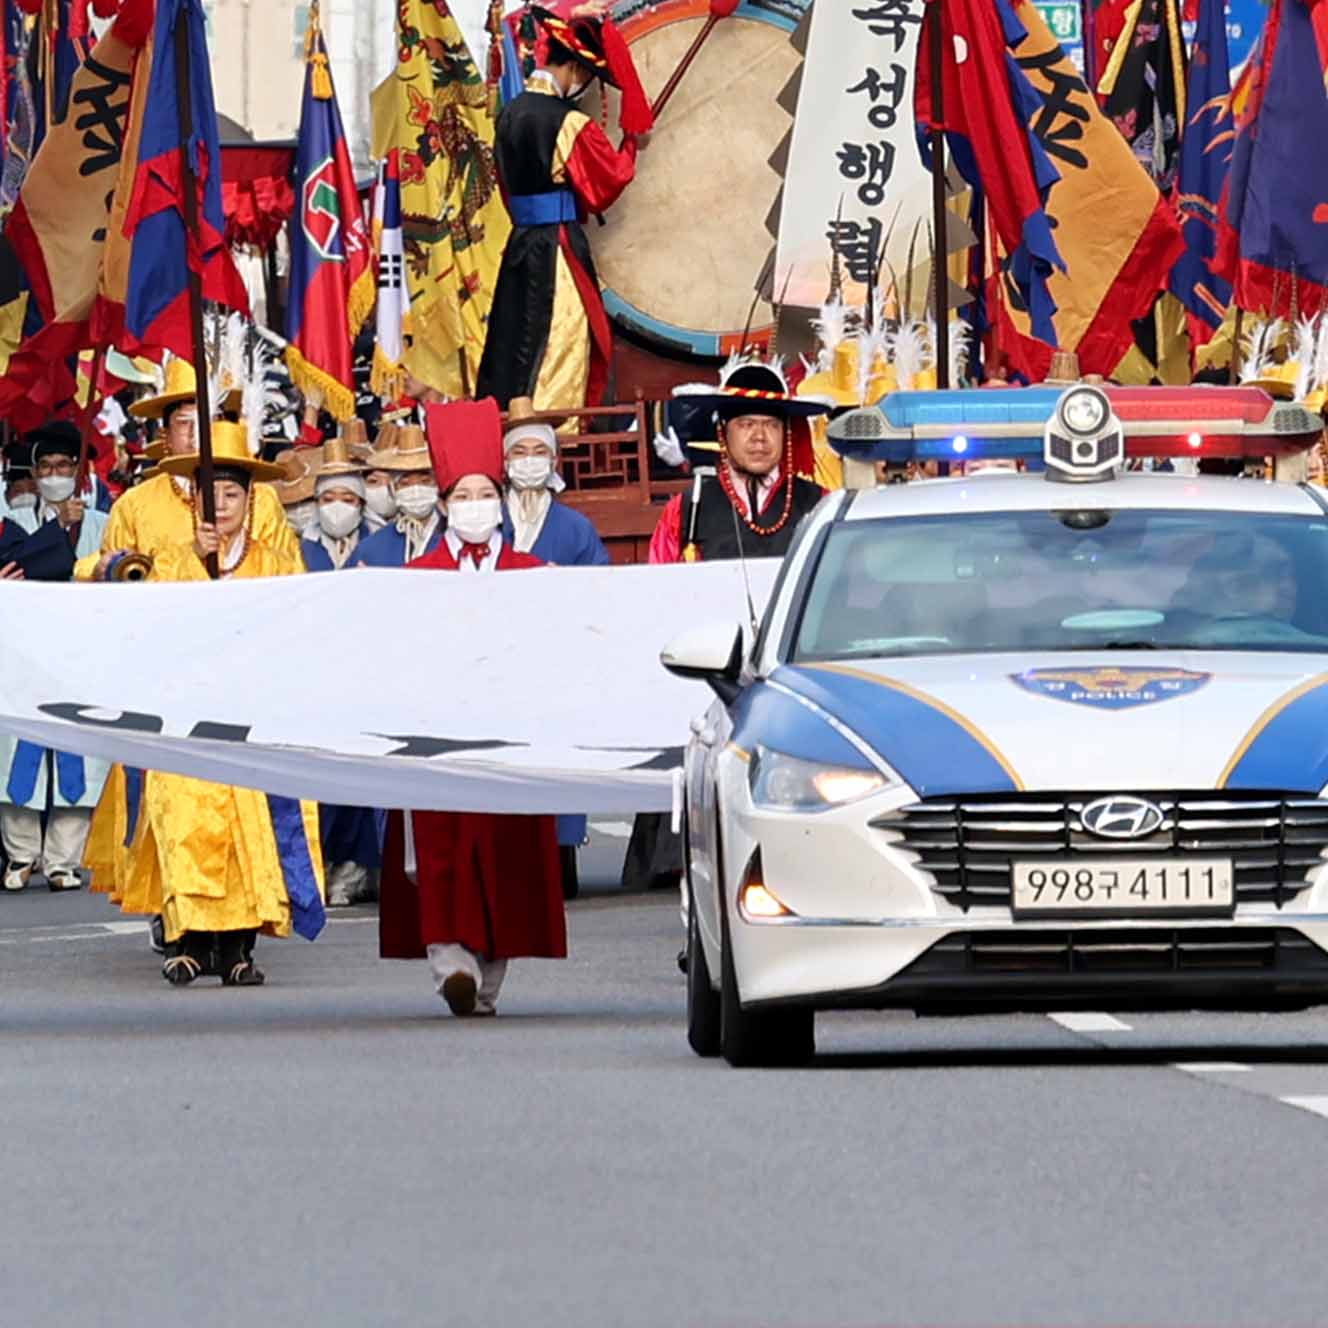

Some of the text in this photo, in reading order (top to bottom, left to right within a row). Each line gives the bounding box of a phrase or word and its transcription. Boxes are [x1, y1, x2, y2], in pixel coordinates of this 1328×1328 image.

[1071, 690, 1156, 701] POLICE
[1027, 866, 1215, 903] 998구 4111
